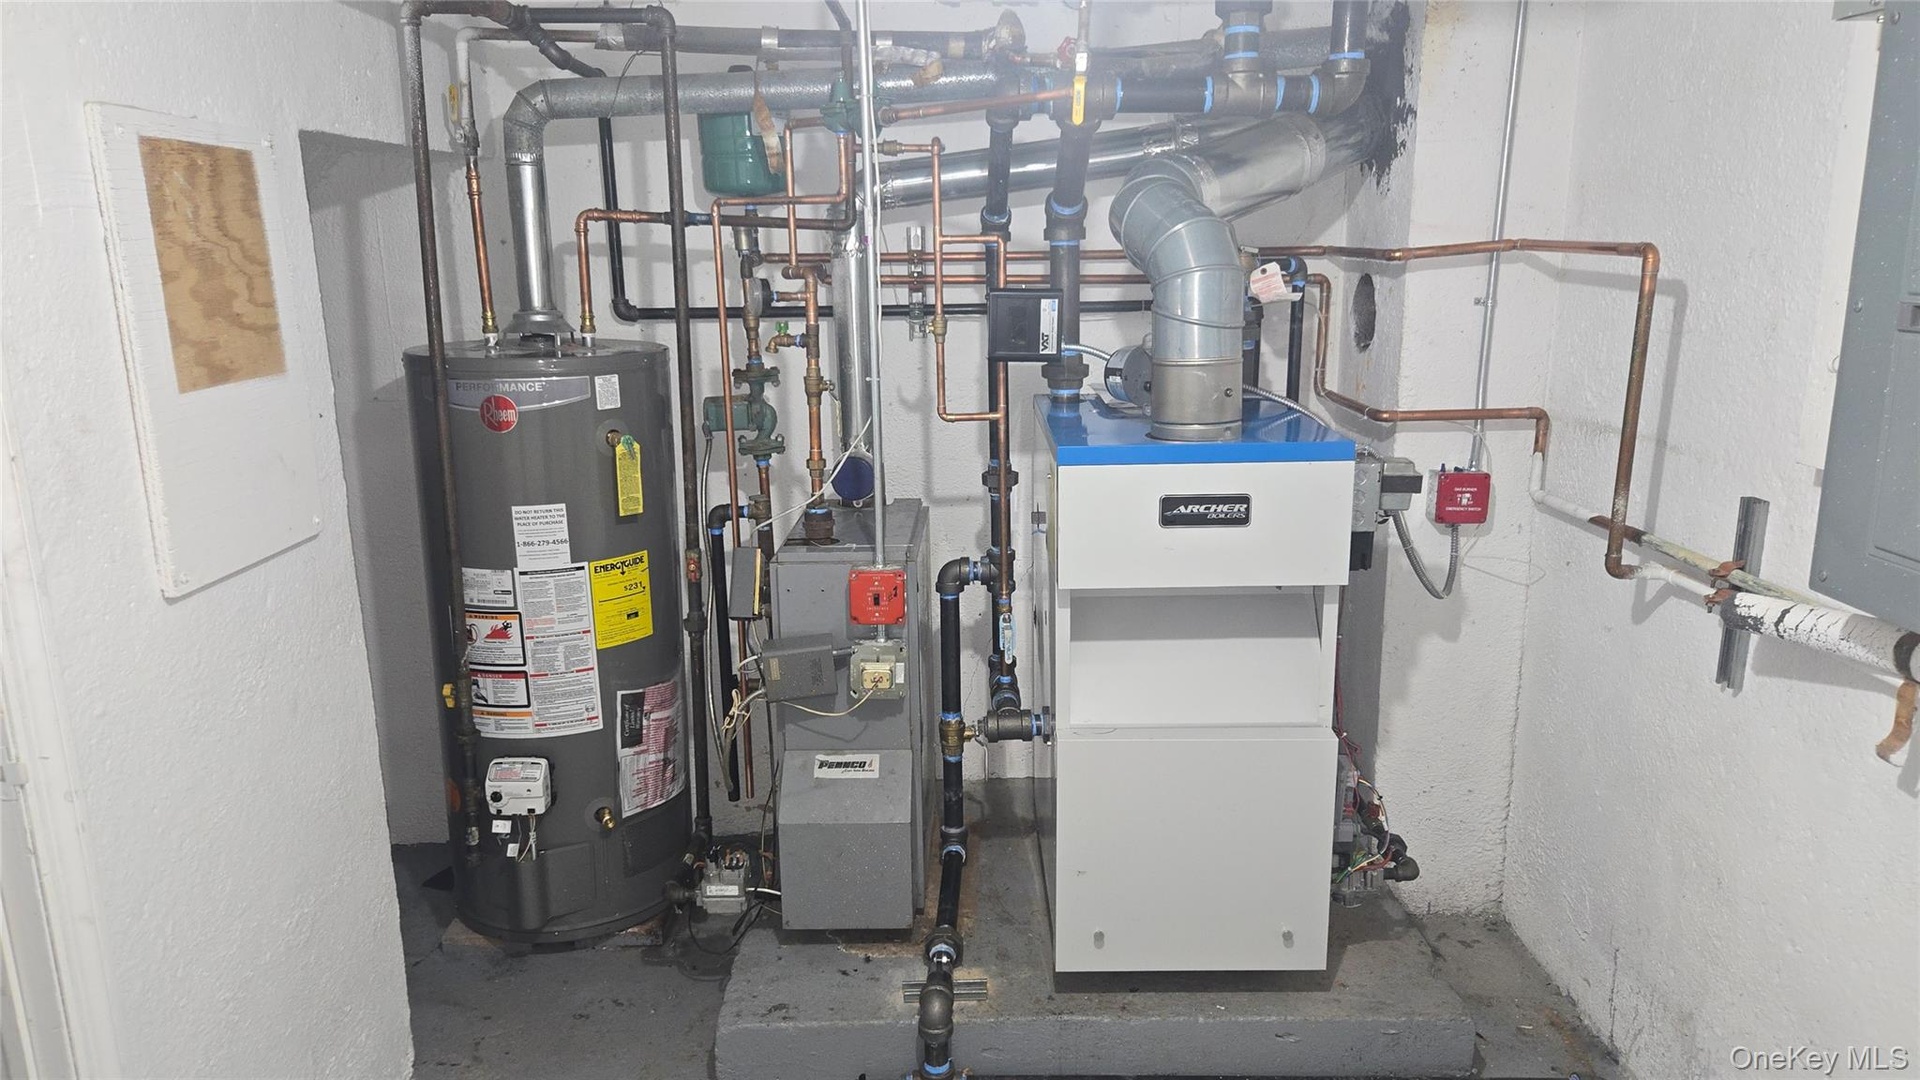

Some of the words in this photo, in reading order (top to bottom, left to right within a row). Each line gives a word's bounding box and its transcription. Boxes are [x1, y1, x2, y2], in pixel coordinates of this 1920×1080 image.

[455, 382, 543, 392] PERFORMANCE
[482, 396, 517, 427] Rheem
[1171, 504, 1249, 514] ARCHER
